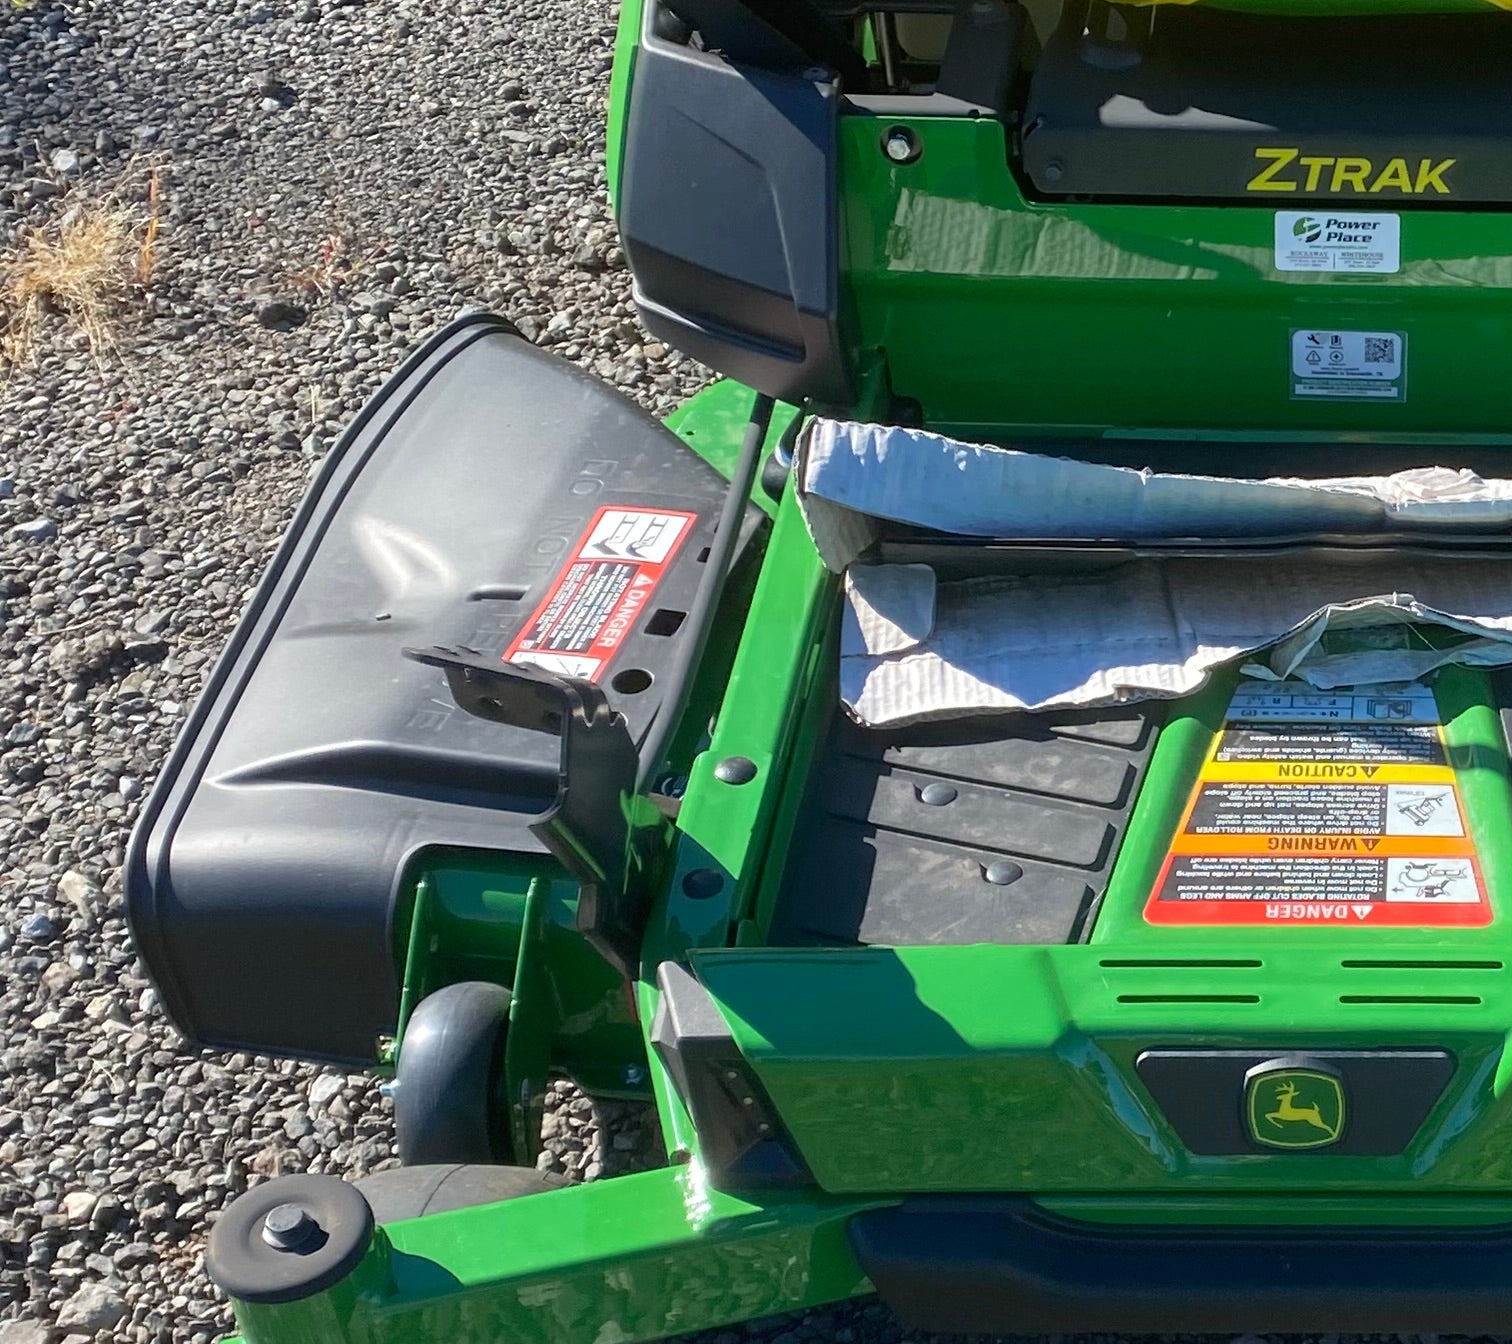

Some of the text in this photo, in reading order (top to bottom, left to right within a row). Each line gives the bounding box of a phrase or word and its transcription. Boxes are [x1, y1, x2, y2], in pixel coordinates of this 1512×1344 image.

[1247, 147, 1457, 195] ZTRAK
[1325, 218, 1380, 230] Power
[1326, 232, 1373, 243] Place
[597, 590, 644, 648] DANGER
[1278, 764, 1357, 778] CAUTION
[1267, 837, 1357, 851] WARNING
[1266, 904, 1348, 919] DANGER
